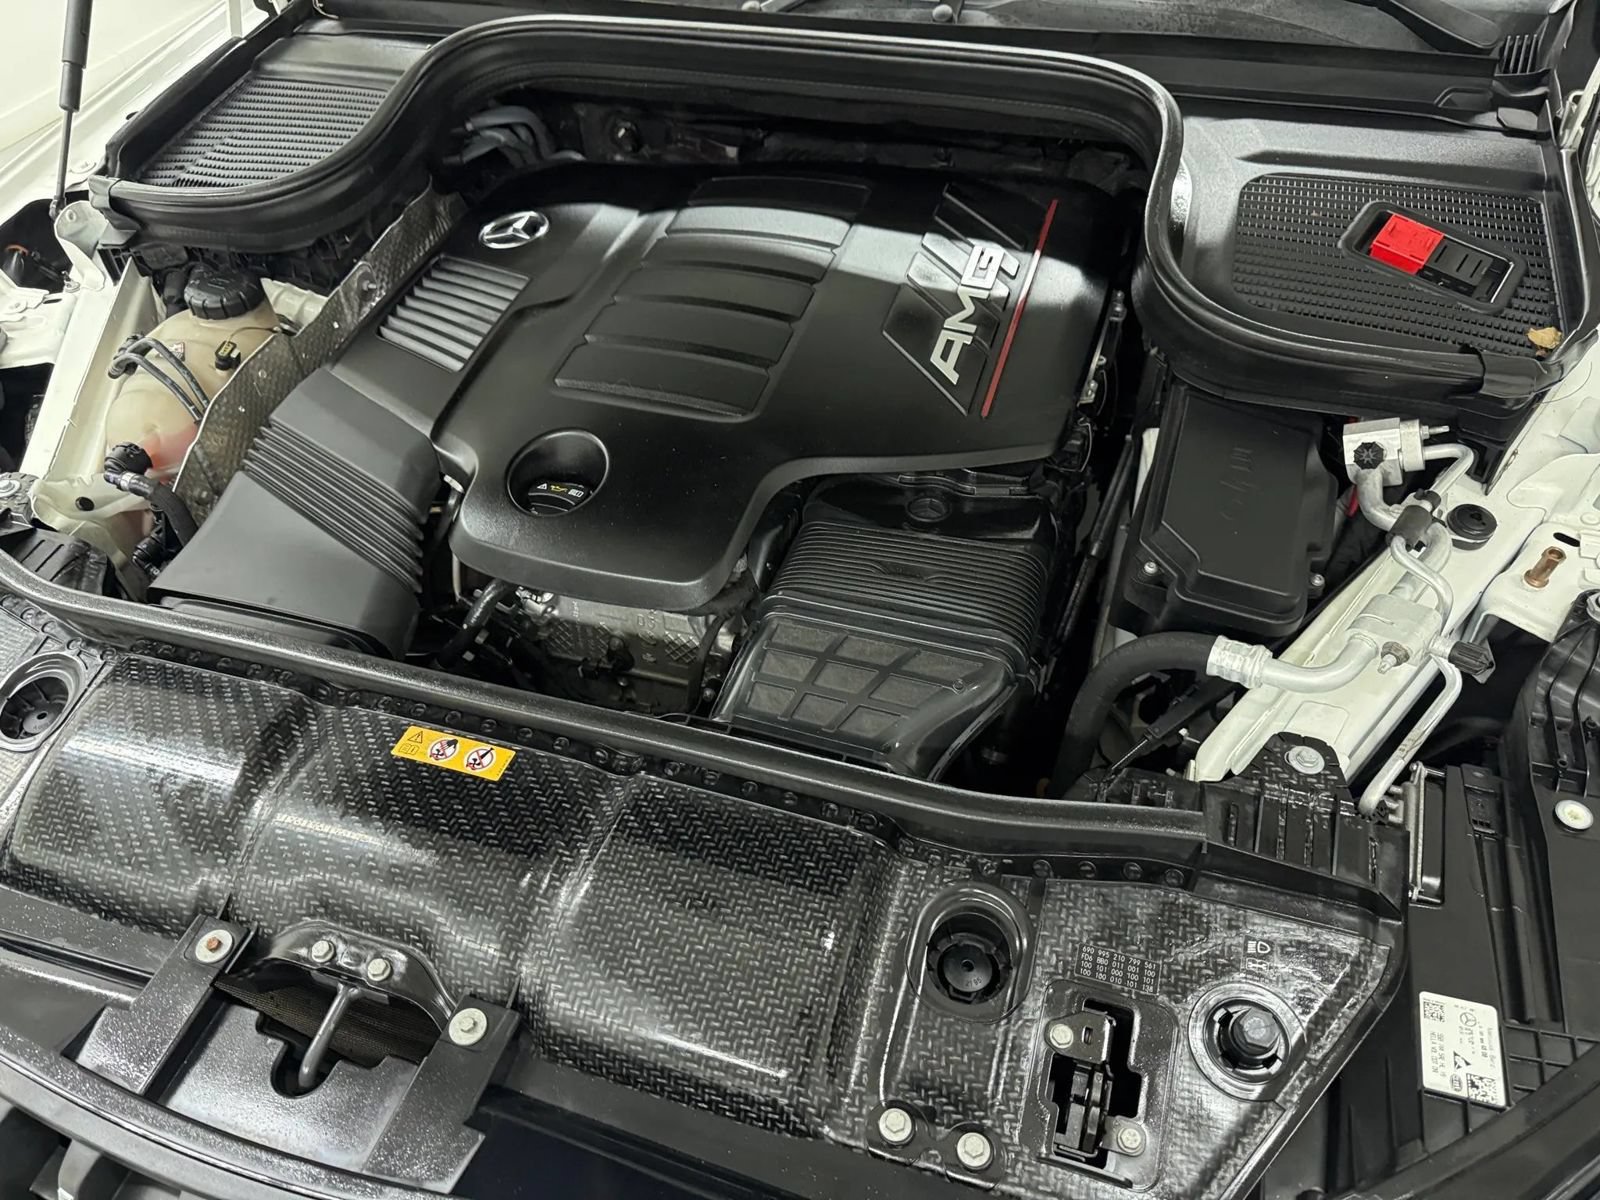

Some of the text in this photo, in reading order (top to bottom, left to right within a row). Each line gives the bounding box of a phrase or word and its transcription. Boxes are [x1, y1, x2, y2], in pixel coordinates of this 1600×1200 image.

[930, 244, 1005, 385] AMG
[1112, 961, 1124, 969] 011
[1144, 970, 1156, 978] 100
[1114, 954, 1126, 962] 210
[1128, 958, 1140, 966] 799
[1144, 962, 1156, 970] 561
[1080, 969, 1092, 977] 100
[1110, 977, 1122, 985] 010
[1082, 961, 1092, 969] 100
[1110, 969, 1122, 977] 000
[1128, 973, 1138, 981] 100
[1144, 977, 1154, 985] 101
